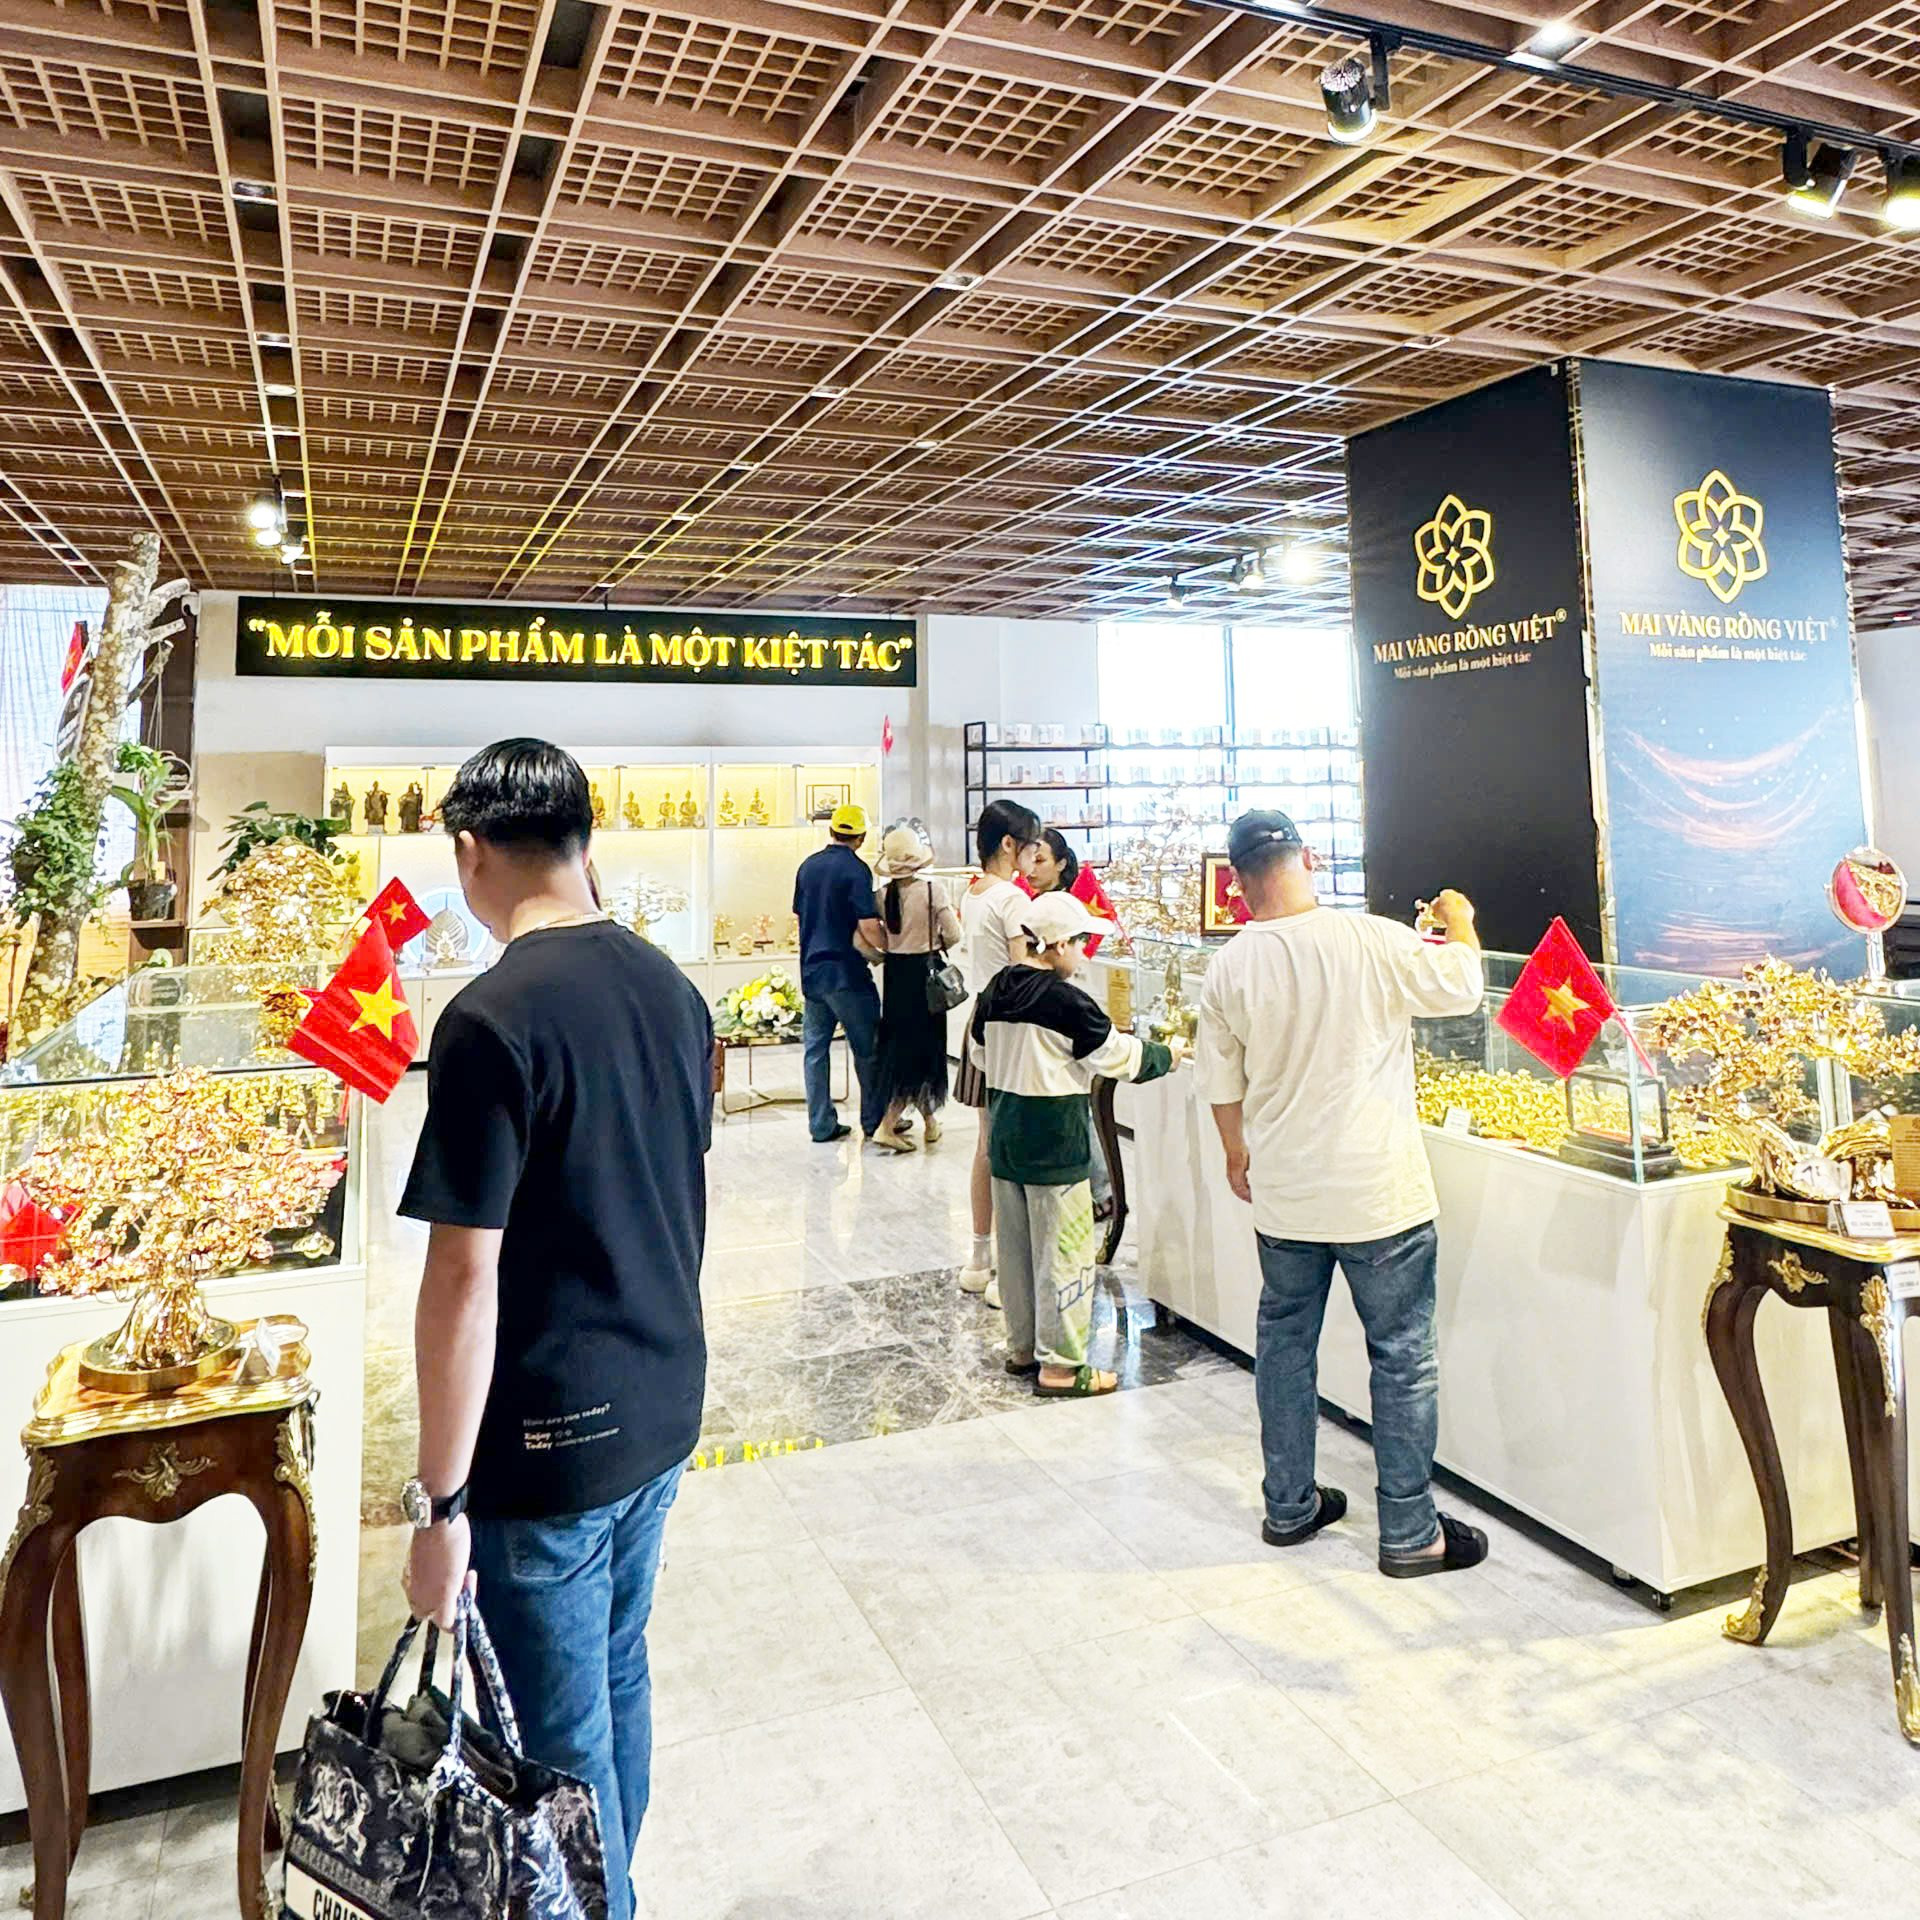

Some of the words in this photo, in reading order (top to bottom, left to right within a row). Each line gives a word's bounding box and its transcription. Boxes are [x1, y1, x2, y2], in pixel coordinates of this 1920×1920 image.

[1373, 640, 1403, 664] MAI
[1405, 633, 1451, 659] VÀNG
[1454, 624, 1507, 652] RỒNG
[1619, 611, 1662, 636] MAI
[1664, 609, 1722, 639] VÀNG
[1724, 611, 1782, 641] RỒNG
[364, 617, 451, 661] SẢN
[459, 616, 585, 664] PHẨM
[594, 625, 644, 666] LÀ
[649, 626, 736, 673] MỘT
[743, 631, 829, 675] KIỆT
